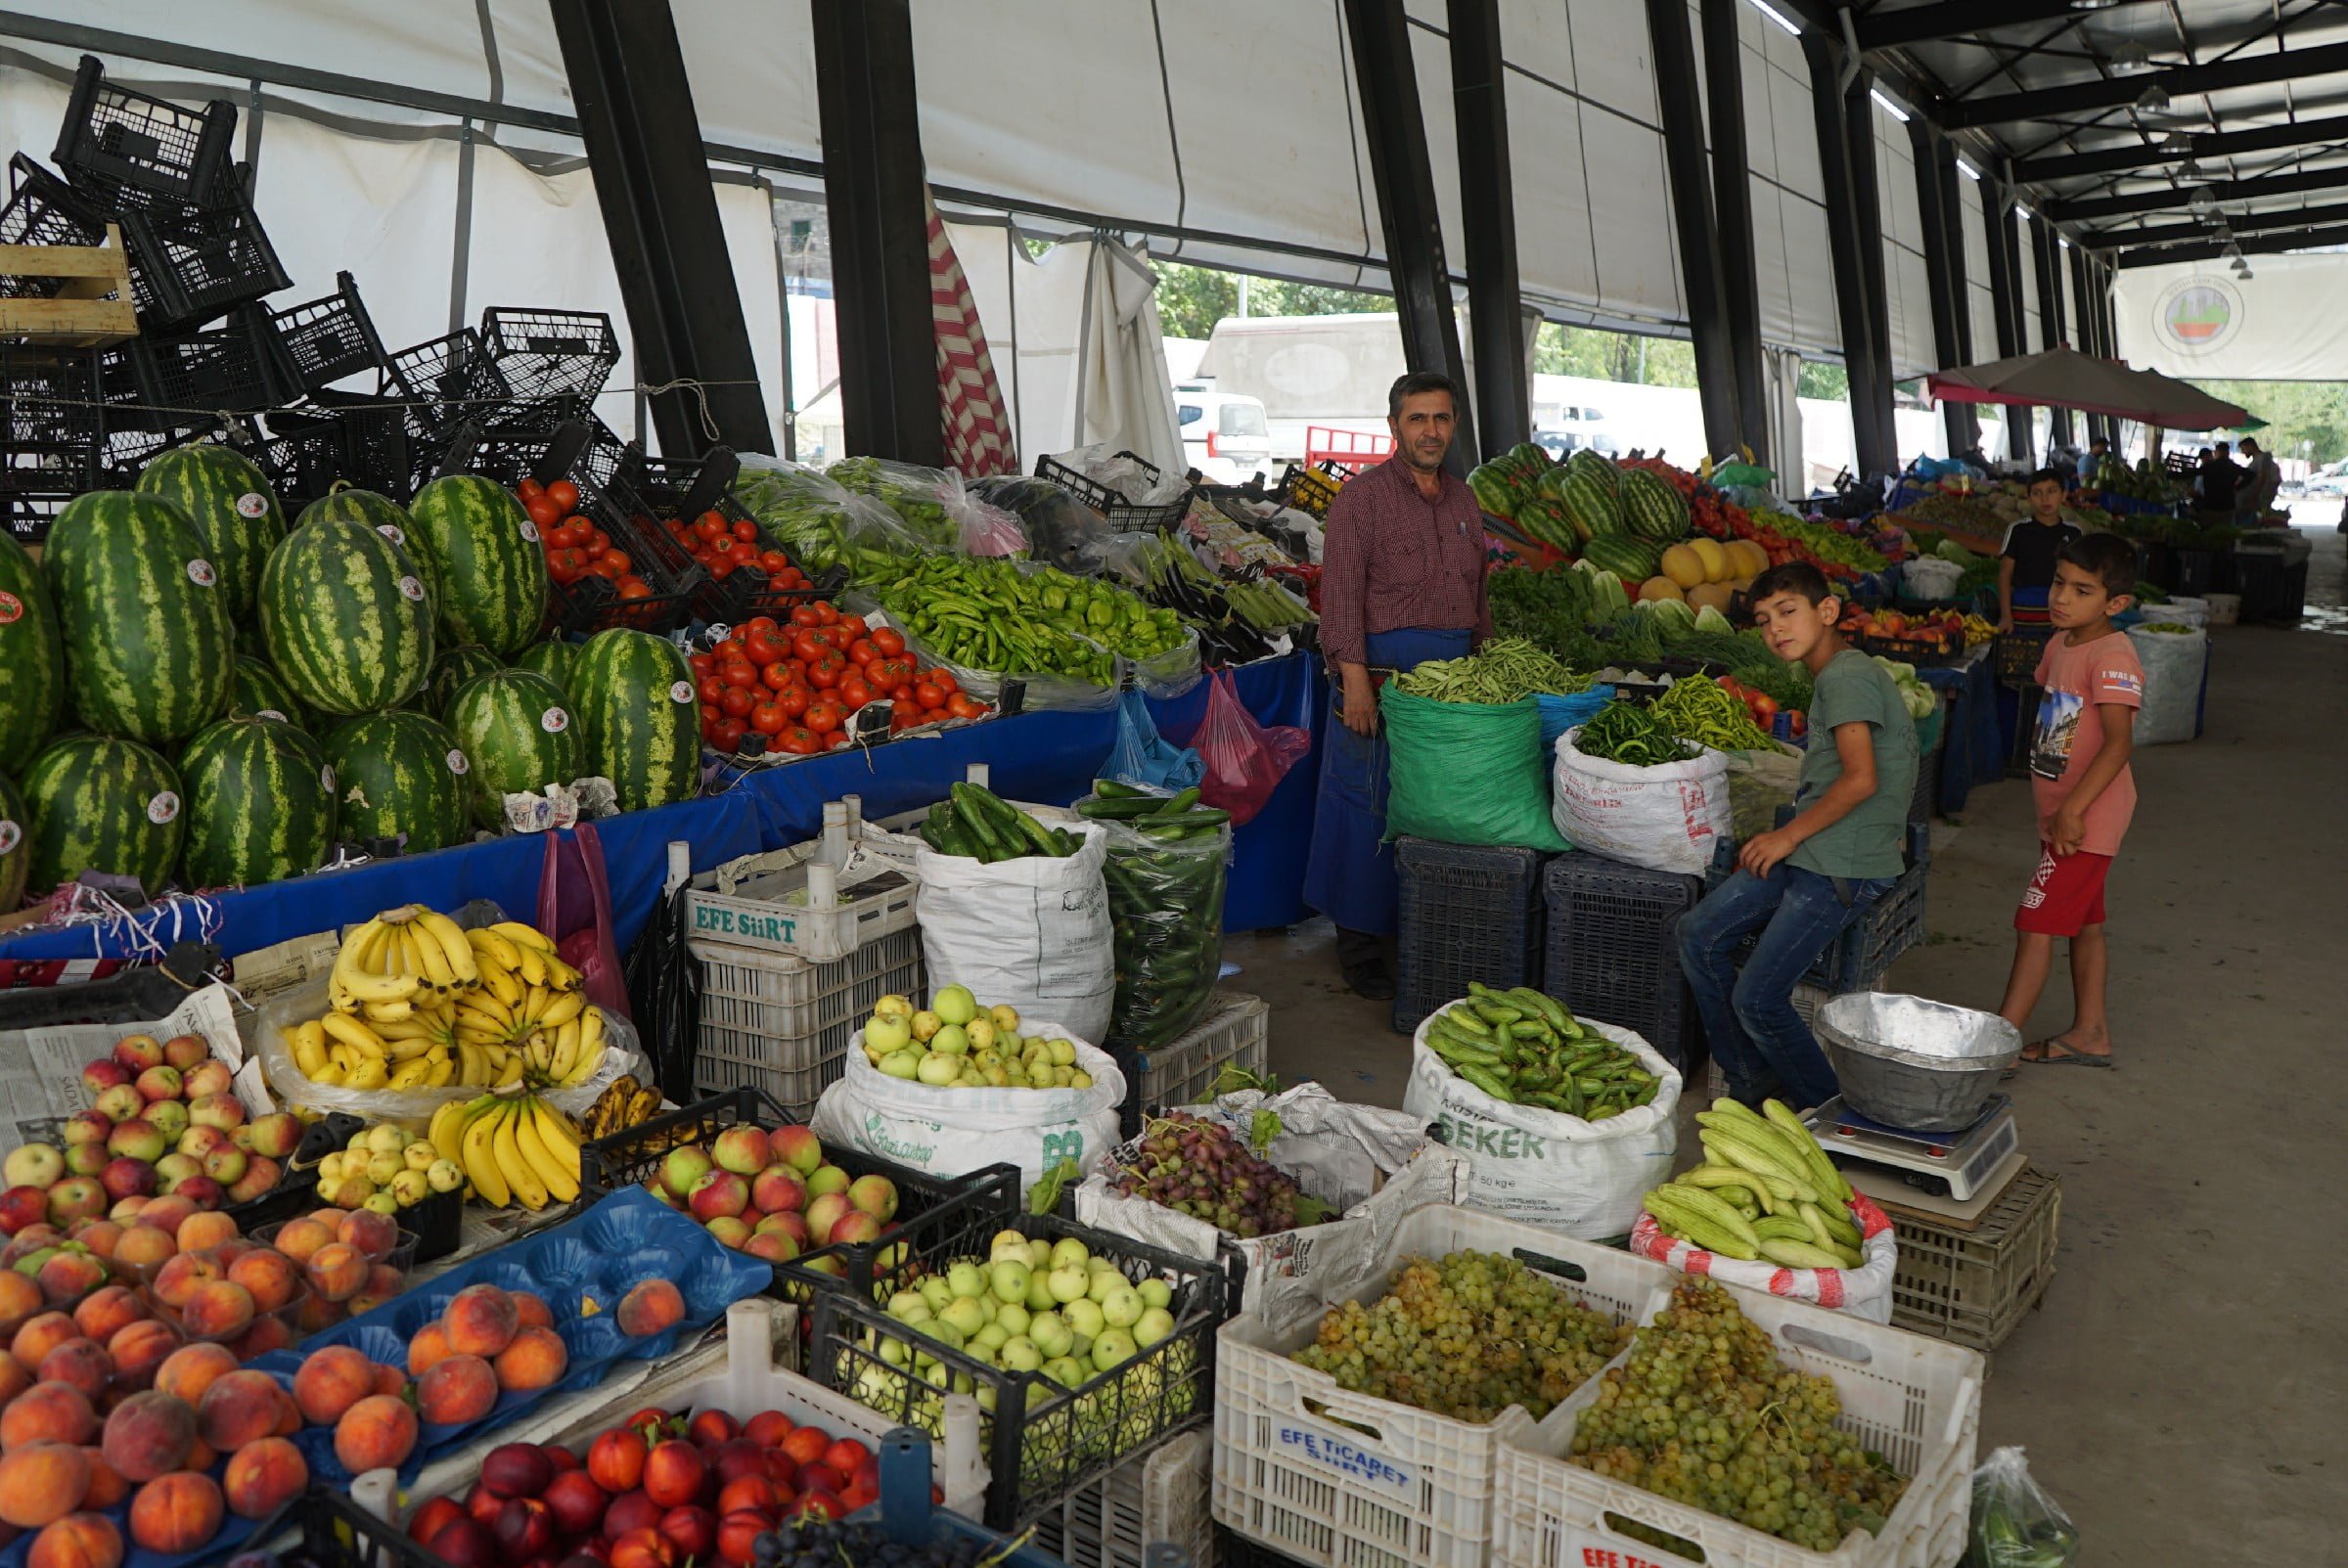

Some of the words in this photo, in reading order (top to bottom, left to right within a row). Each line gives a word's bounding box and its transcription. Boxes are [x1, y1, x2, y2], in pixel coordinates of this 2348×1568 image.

[696, 906, 735, 933] EFE
[1480, 1176, 1493, 1187] 50
[1495, 1177, 1508, 1189] kg
[1281, 1428, 1317, 1450] EFE
[1582, 1547, 1619, 1568] EFE
